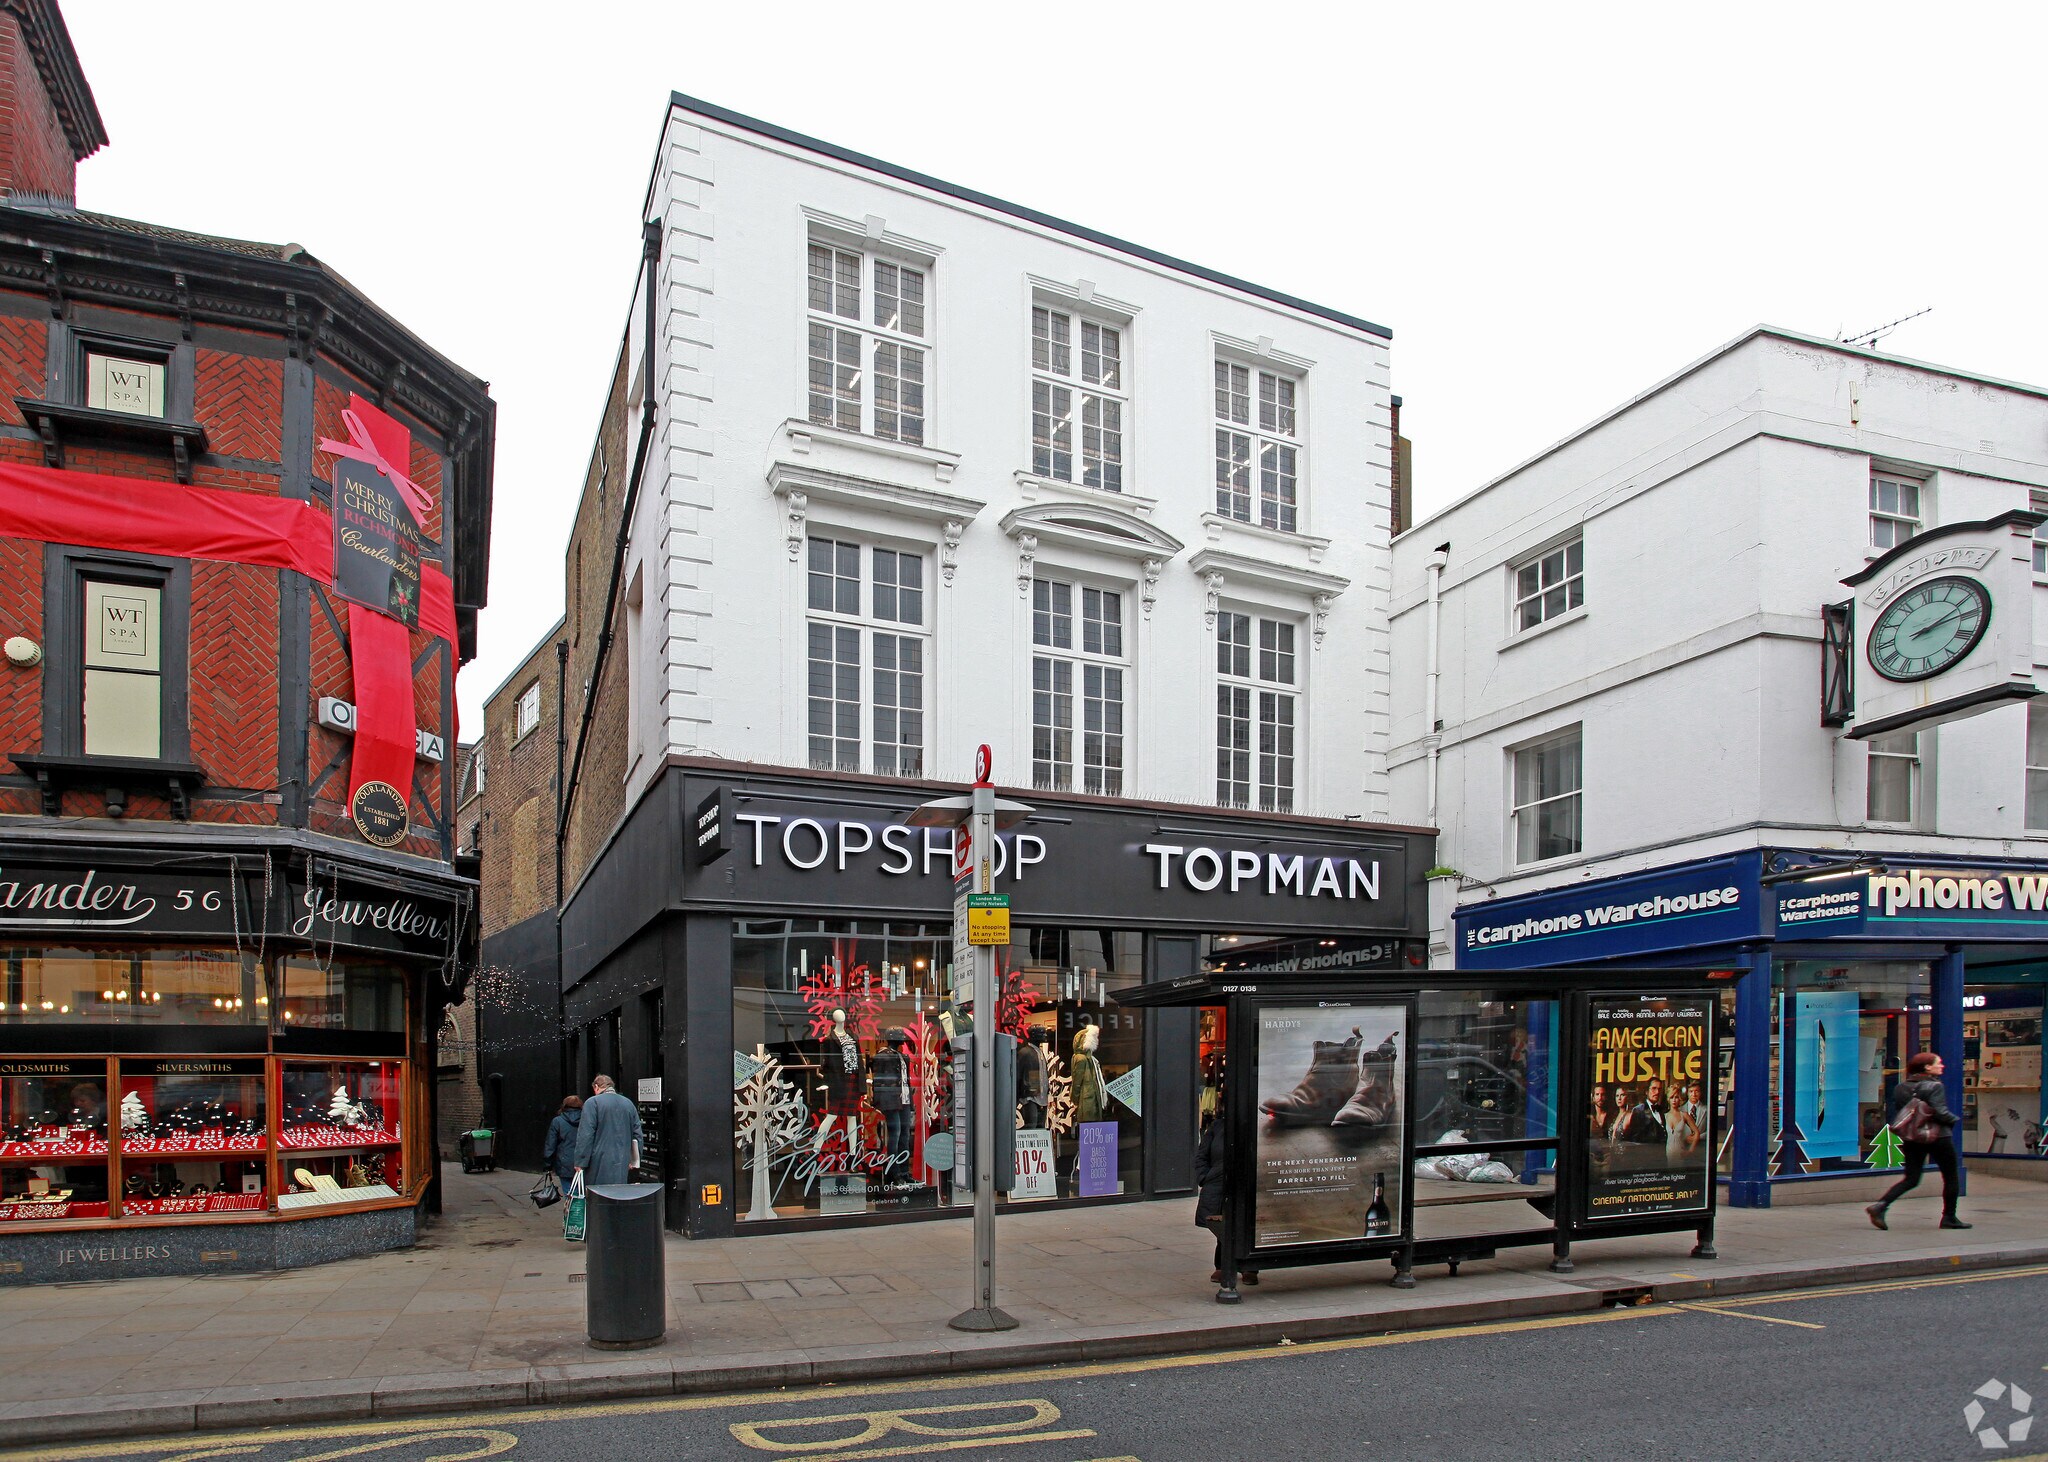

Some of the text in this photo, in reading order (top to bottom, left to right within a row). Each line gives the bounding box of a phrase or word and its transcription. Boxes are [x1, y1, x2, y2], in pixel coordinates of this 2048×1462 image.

[110, 371, 147, 389] WT
[113, 392, 142, 403] SPA
[345, 477, 393, 511] MERRY
[344, 492, 420, 543] CHRISTMAS
[343, 508, 419, 557] RICHMOND
[340, 527, 419, 581] Courlanders
[107, 608, 142, 623] WT
[110, 628, 137, 638] SPA
[978, 751, 985, 778] B
[357, 784, 406, 817] COURLANDERS
[364, 807, 400, 821] ESTABLISHED
[374, 816, 389, 827] 1881
[698, 805, 719, 829] TOPSHOP
[358, 818, 369, 834] THE
[698, 823, 719, 846] TOPMAN
[371, 828, 403, 843] JEWELLERS
[1146, 843, 1379, 899] TOPMAN
[173, 889, 222, 911] 56
[1787, 891, 1860, 909] Carphone
[2008, 875, 2048, 910] W
[293, 887, 449, 941] Jewellers
[1467, 886, 1740, 947] THE Carphone Warehouse
[1780, 903, 1859, 922] Warehouse
[1222, 985, 1257, 993] 0127 0136
[1265, 1020, 1301, 1029] HARDYS
[1596, 1025, 1702, 1050] AMERICAN
[156, 1063, 232, 1073] SILVERSMITHS
[1595, 1050, 1702, 1083] HUSTLE
[1107, 1072, 1135, 1092] ORDER ONLINE
[1115, 1085, 1130, 1097] COLLECT
[1121, 1090, 1133, 1099] STORE
[1025, 1139, 1049, 1148] TIME OFFER
[1083, 1127, 1114, 1145] 20% OFF
[1091, 1146, 1106, 1157] BAGS
[1090, 1156, 1107, 1168] SHOES
[1308, 1156, 1357, 1165] GENERATION
[1090, 1167, 1107, 1179] BOOTS
[883, 1181, 894, 1192] of
[1025, 1175, 1038, 1189] OFF
[705, 1186, 719, 1203] H
[1592, 1196, 1627, 1206] CINEMAS
[1628, 1192, 1674, 1203] NATIONWIDE
[1675, 1190, 1689, 1200] JAN
[58, 1244, 171, 1267] JEWELLERS
